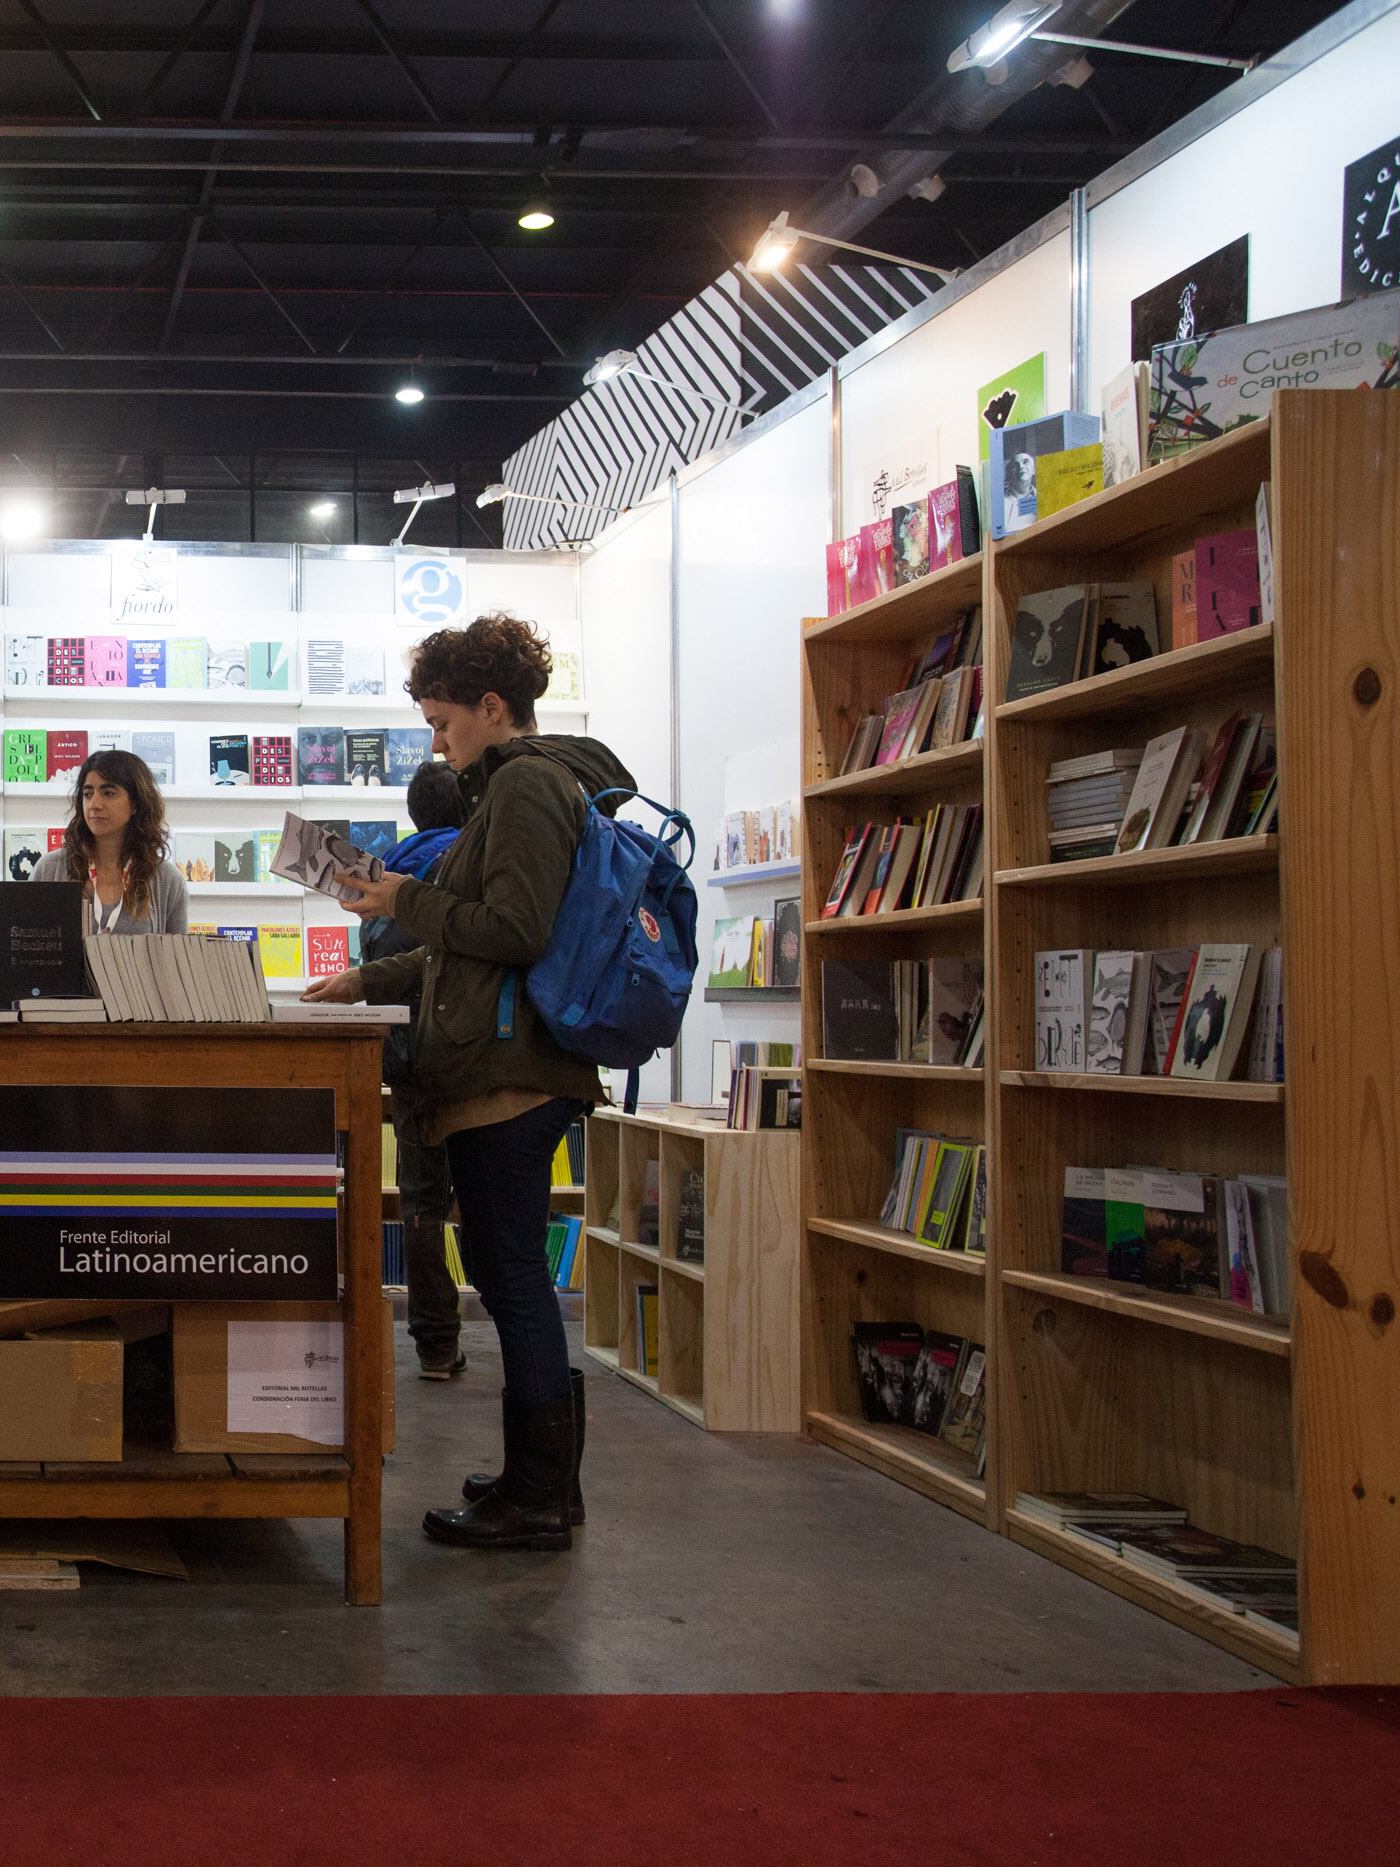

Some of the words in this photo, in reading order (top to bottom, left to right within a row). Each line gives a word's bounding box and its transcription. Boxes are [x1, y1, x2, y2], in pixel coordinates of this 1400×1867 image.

[1243, 338, 1362, 374] Cuento
[1216, 374, 1238, 388] de
[1239, 370, 1320, 399] Canto
[116, 594, 174, 621] fiordo
[10, 926, 62, 938] Samuel
[313, 951, 344, 962] real
[60, 1230, 109, 1245] Frente
[110, 1229, 171, 1245] Editorial
[59, 1246, 309, 1274] Latinoamericano
